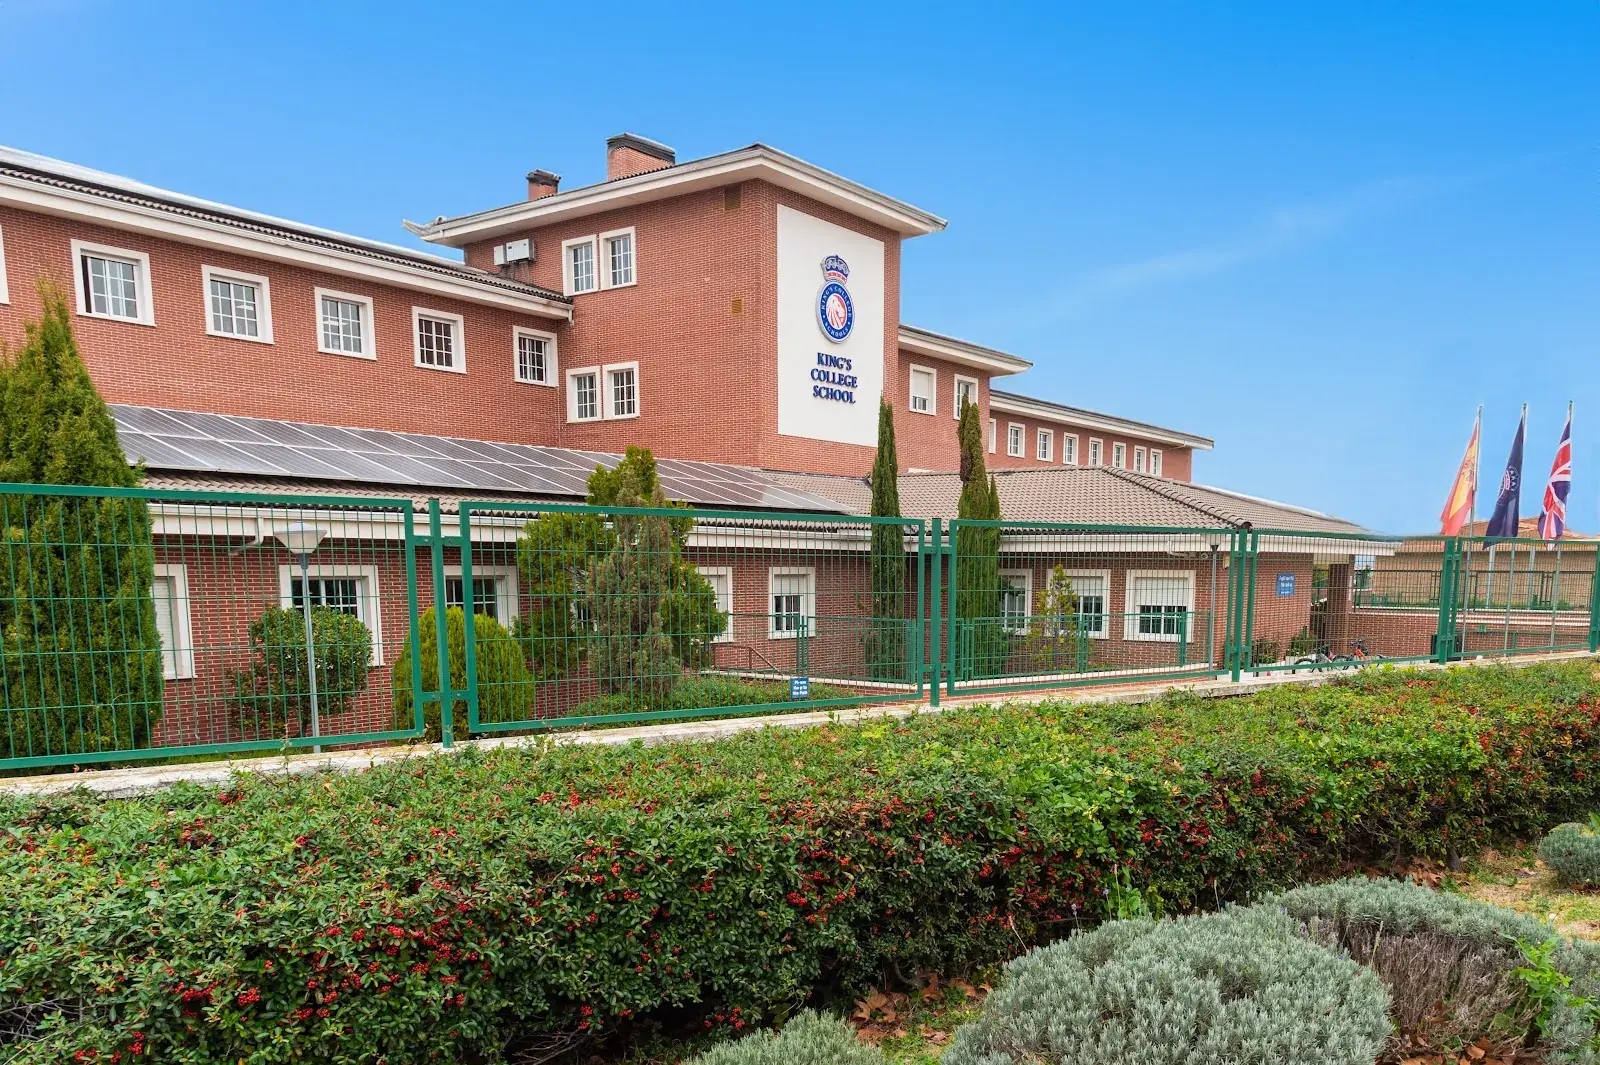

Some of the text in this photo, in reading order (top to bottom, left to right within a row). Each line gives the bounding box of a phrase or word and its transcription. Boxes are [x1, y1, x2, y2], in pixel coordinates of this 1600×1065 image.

[817, 352, 852, 371] KING'S
[810, 368, 858, 388] COLLEGE
[812, 385, 856, 404] SCHOOL
